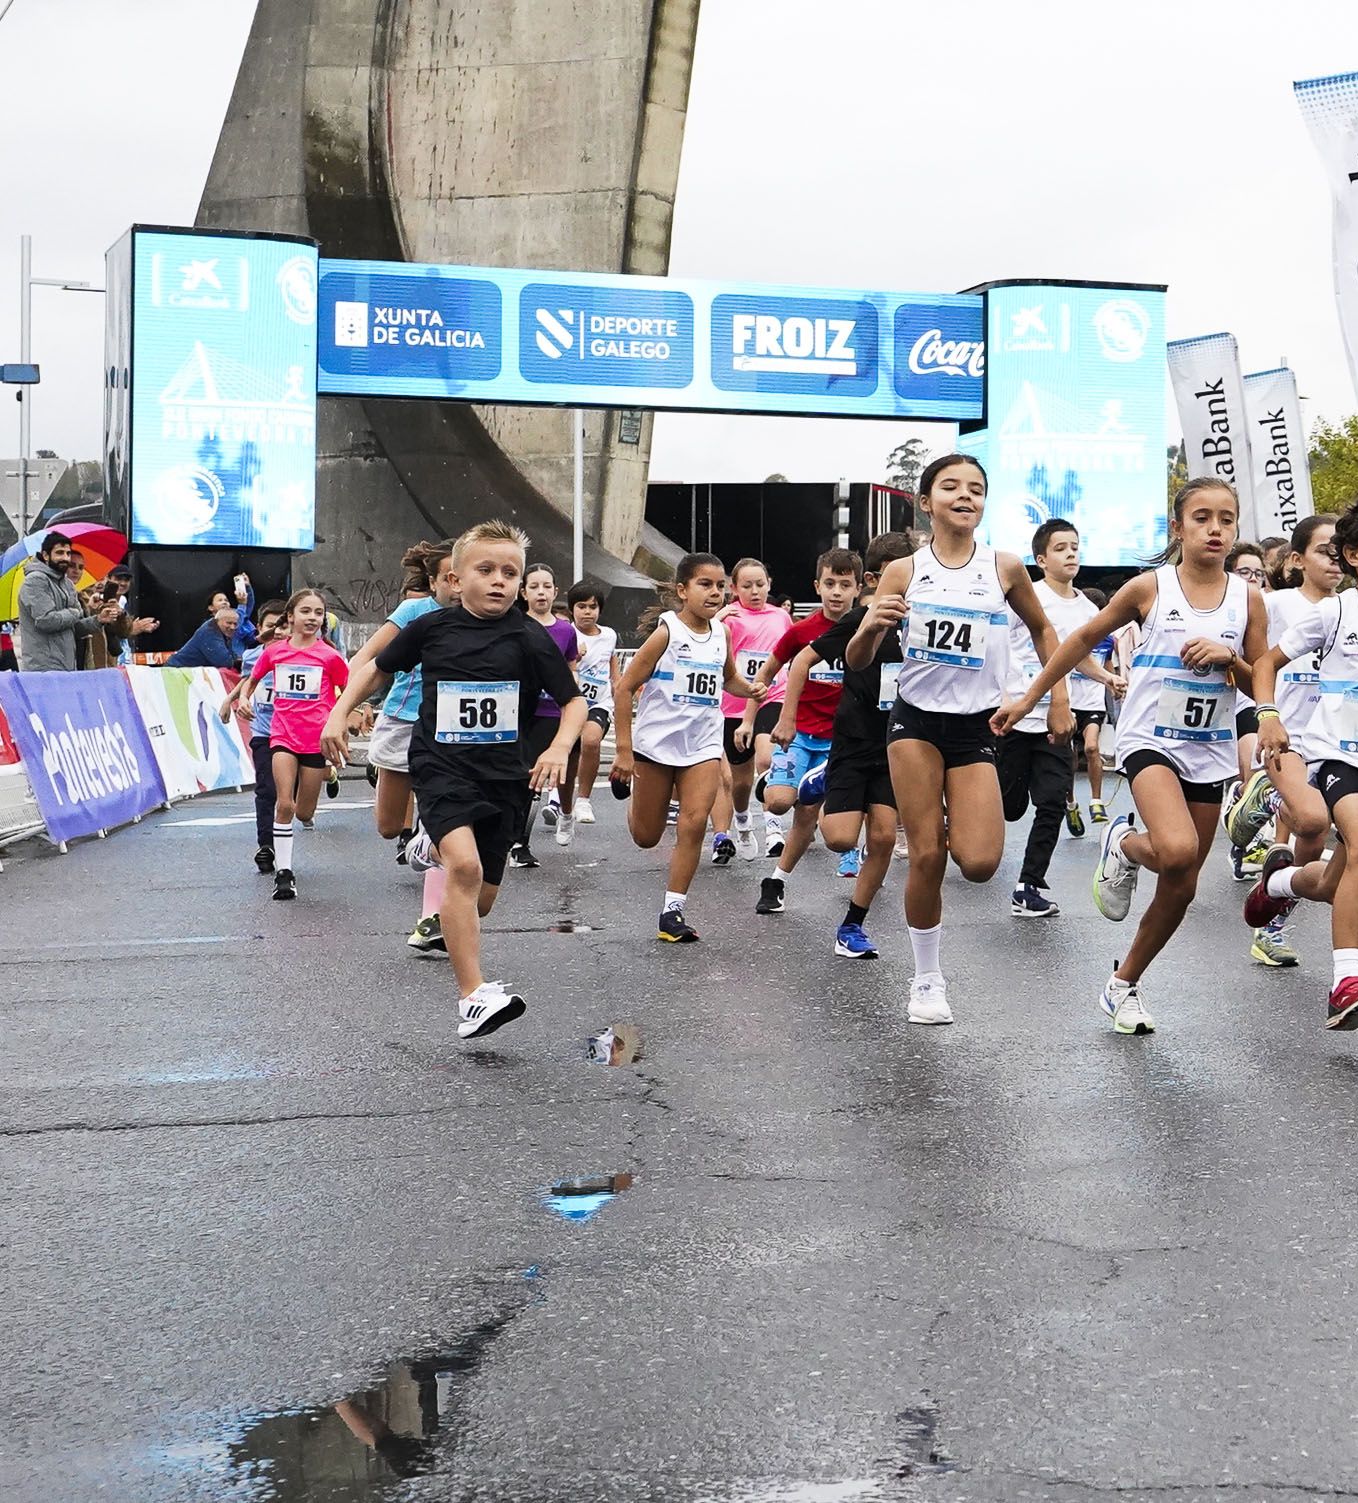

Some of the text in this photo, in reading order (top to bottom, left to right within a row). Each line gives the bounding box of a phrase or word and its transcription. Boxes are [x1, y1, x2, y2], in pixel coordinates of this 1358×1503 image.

[374, 307, 444, 327] XUNTA
[590, 316, 678, 337] DEPORTE
[373, 326, 485, 349] DE GALICIA
[732, 314, 857, 360] FROIZ
[590, 339, 671, 360] GALEGO
[1194, 377, 1236, 476] aBank
[1257, 407, 1298, 532] aixaBank
[924, 619, 972, 653] 124
[288, 673, 306, 692] 15
[582, 682, 599, 700] 25
[686, 672, 717, 696] 165
[459, 697, 498, 729] 58
[1183, 697, 1218, 729] 57
